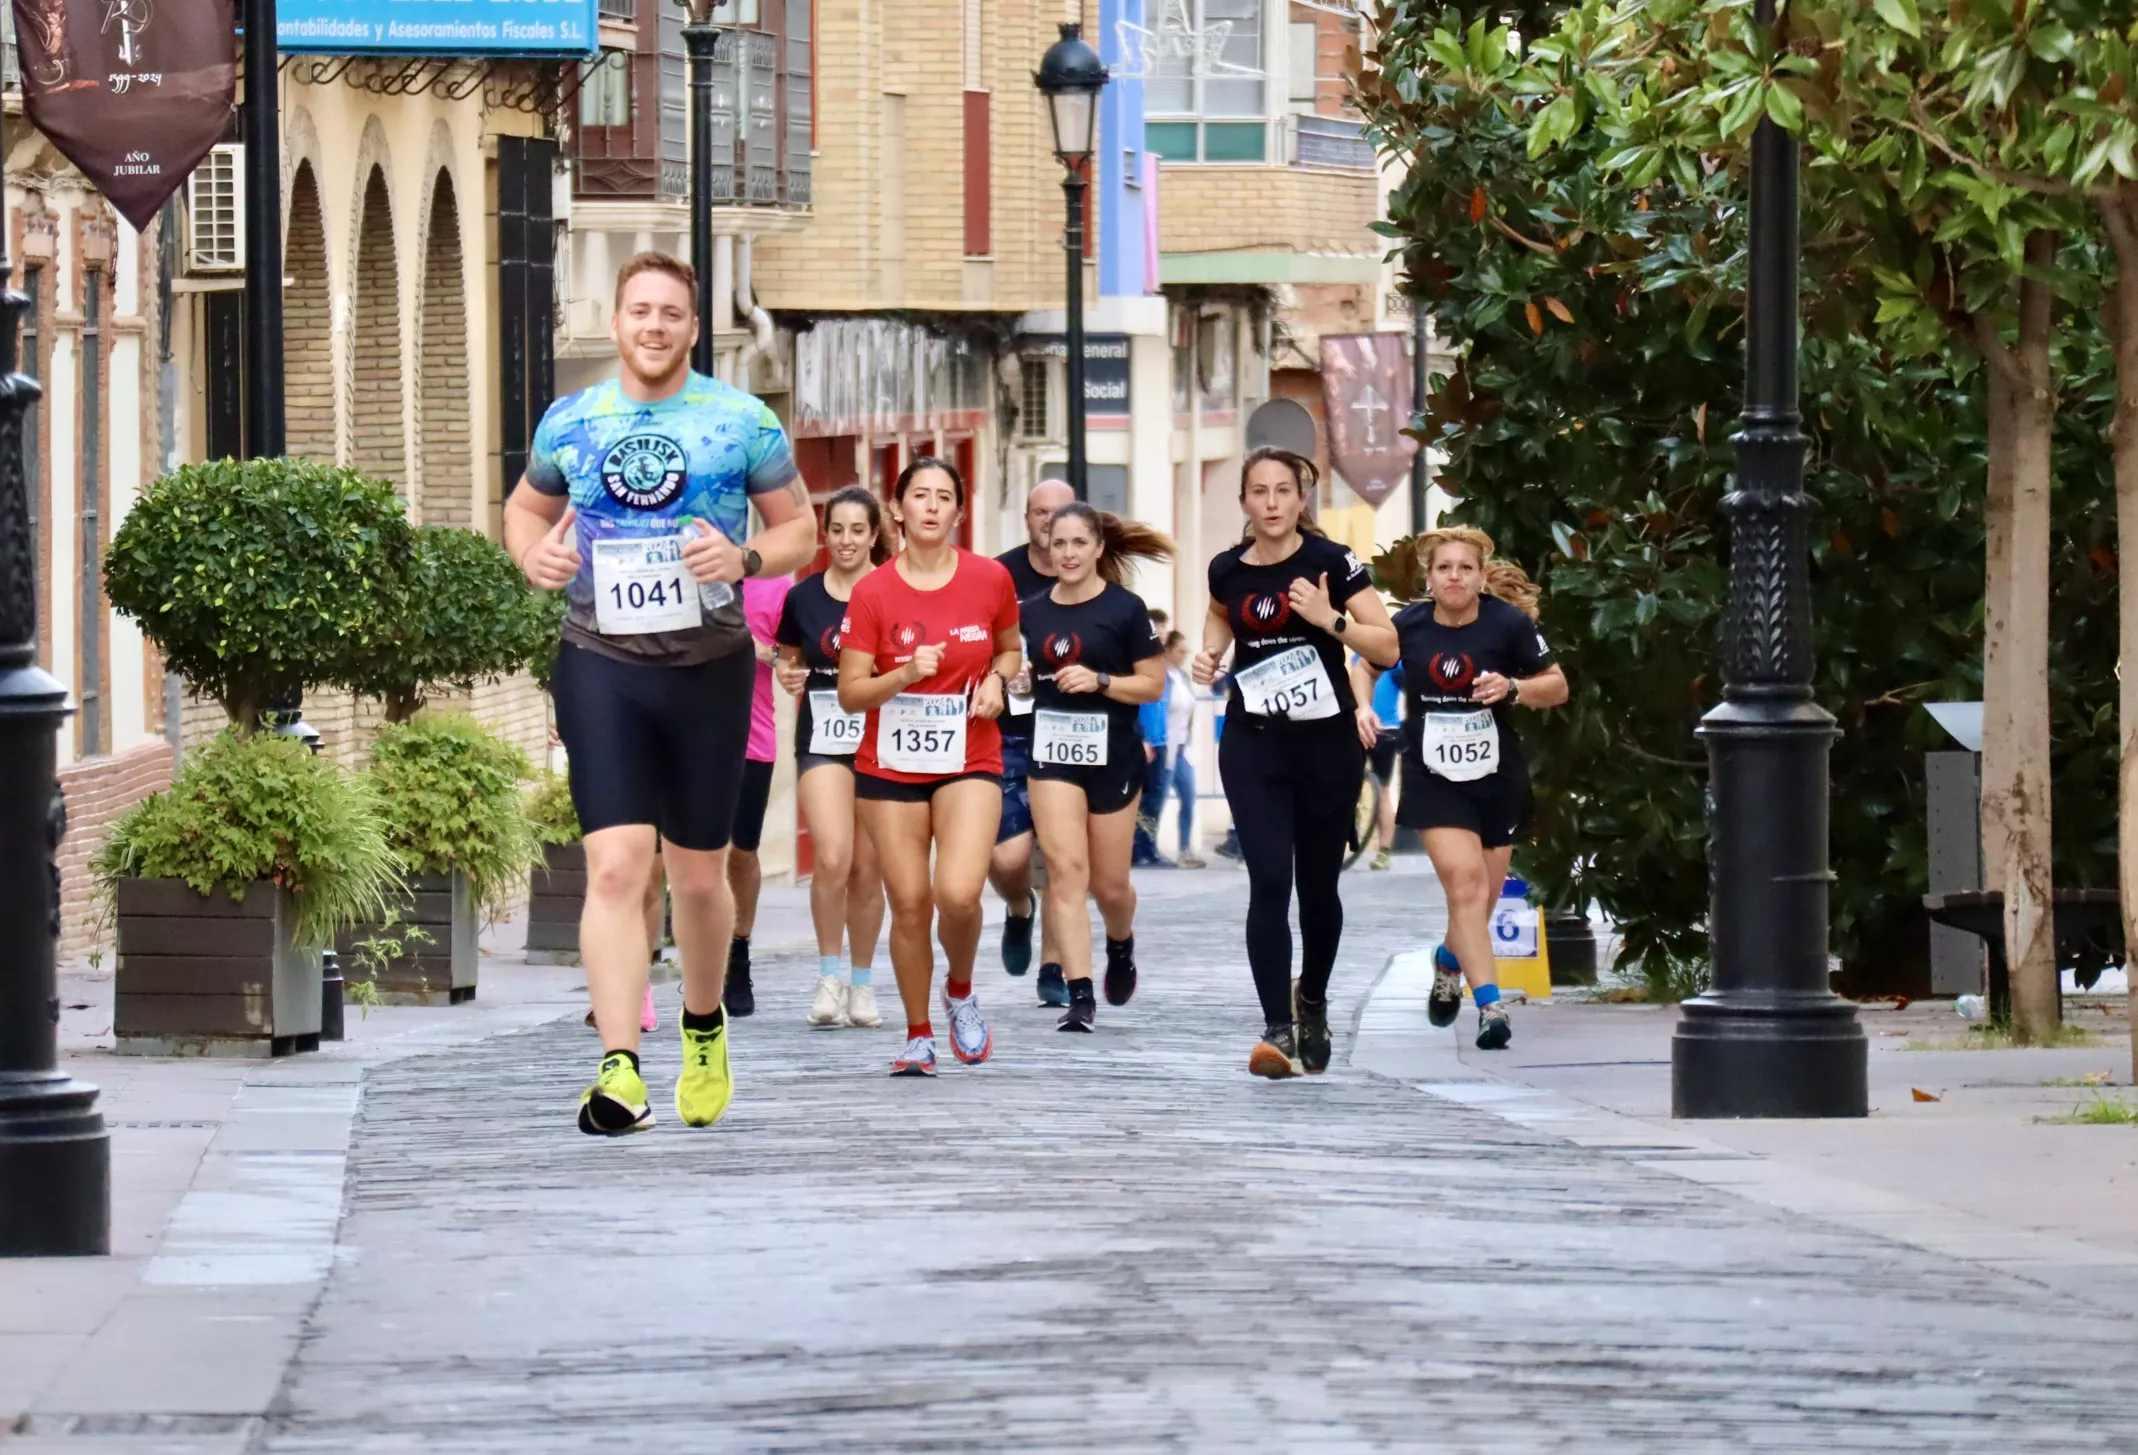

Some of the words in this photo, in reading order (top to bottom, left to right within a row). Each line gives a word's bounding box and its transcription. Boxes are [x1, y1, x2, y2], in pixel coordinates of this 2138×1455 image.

[277, 18, 369, 37] ontabilidades
[374, 25, 383, 42] y
[388, 20, 497, 38] Asesoramientos
[502, 20, 554, 39] Fiscales
[124, 151, 150, 162] AÑO
[113, 164, 160, 176] JUBILAR
[1083, 341, 1127, 358] eneral
[1084, 381, 1125, 398] Social
[607, 474, 628, 498] SAN
[626, 472, 680, 506] FERNANDO
[610, 577, 683, 609] 1041
[1261, 678, 1317, 716] 1057
[823, 718, 867, 738] 105
[891, 729, 955, 752] 1357
[1045, 741, 1098, 763] 1065
[1435, 741, 1491, 763] 1052
